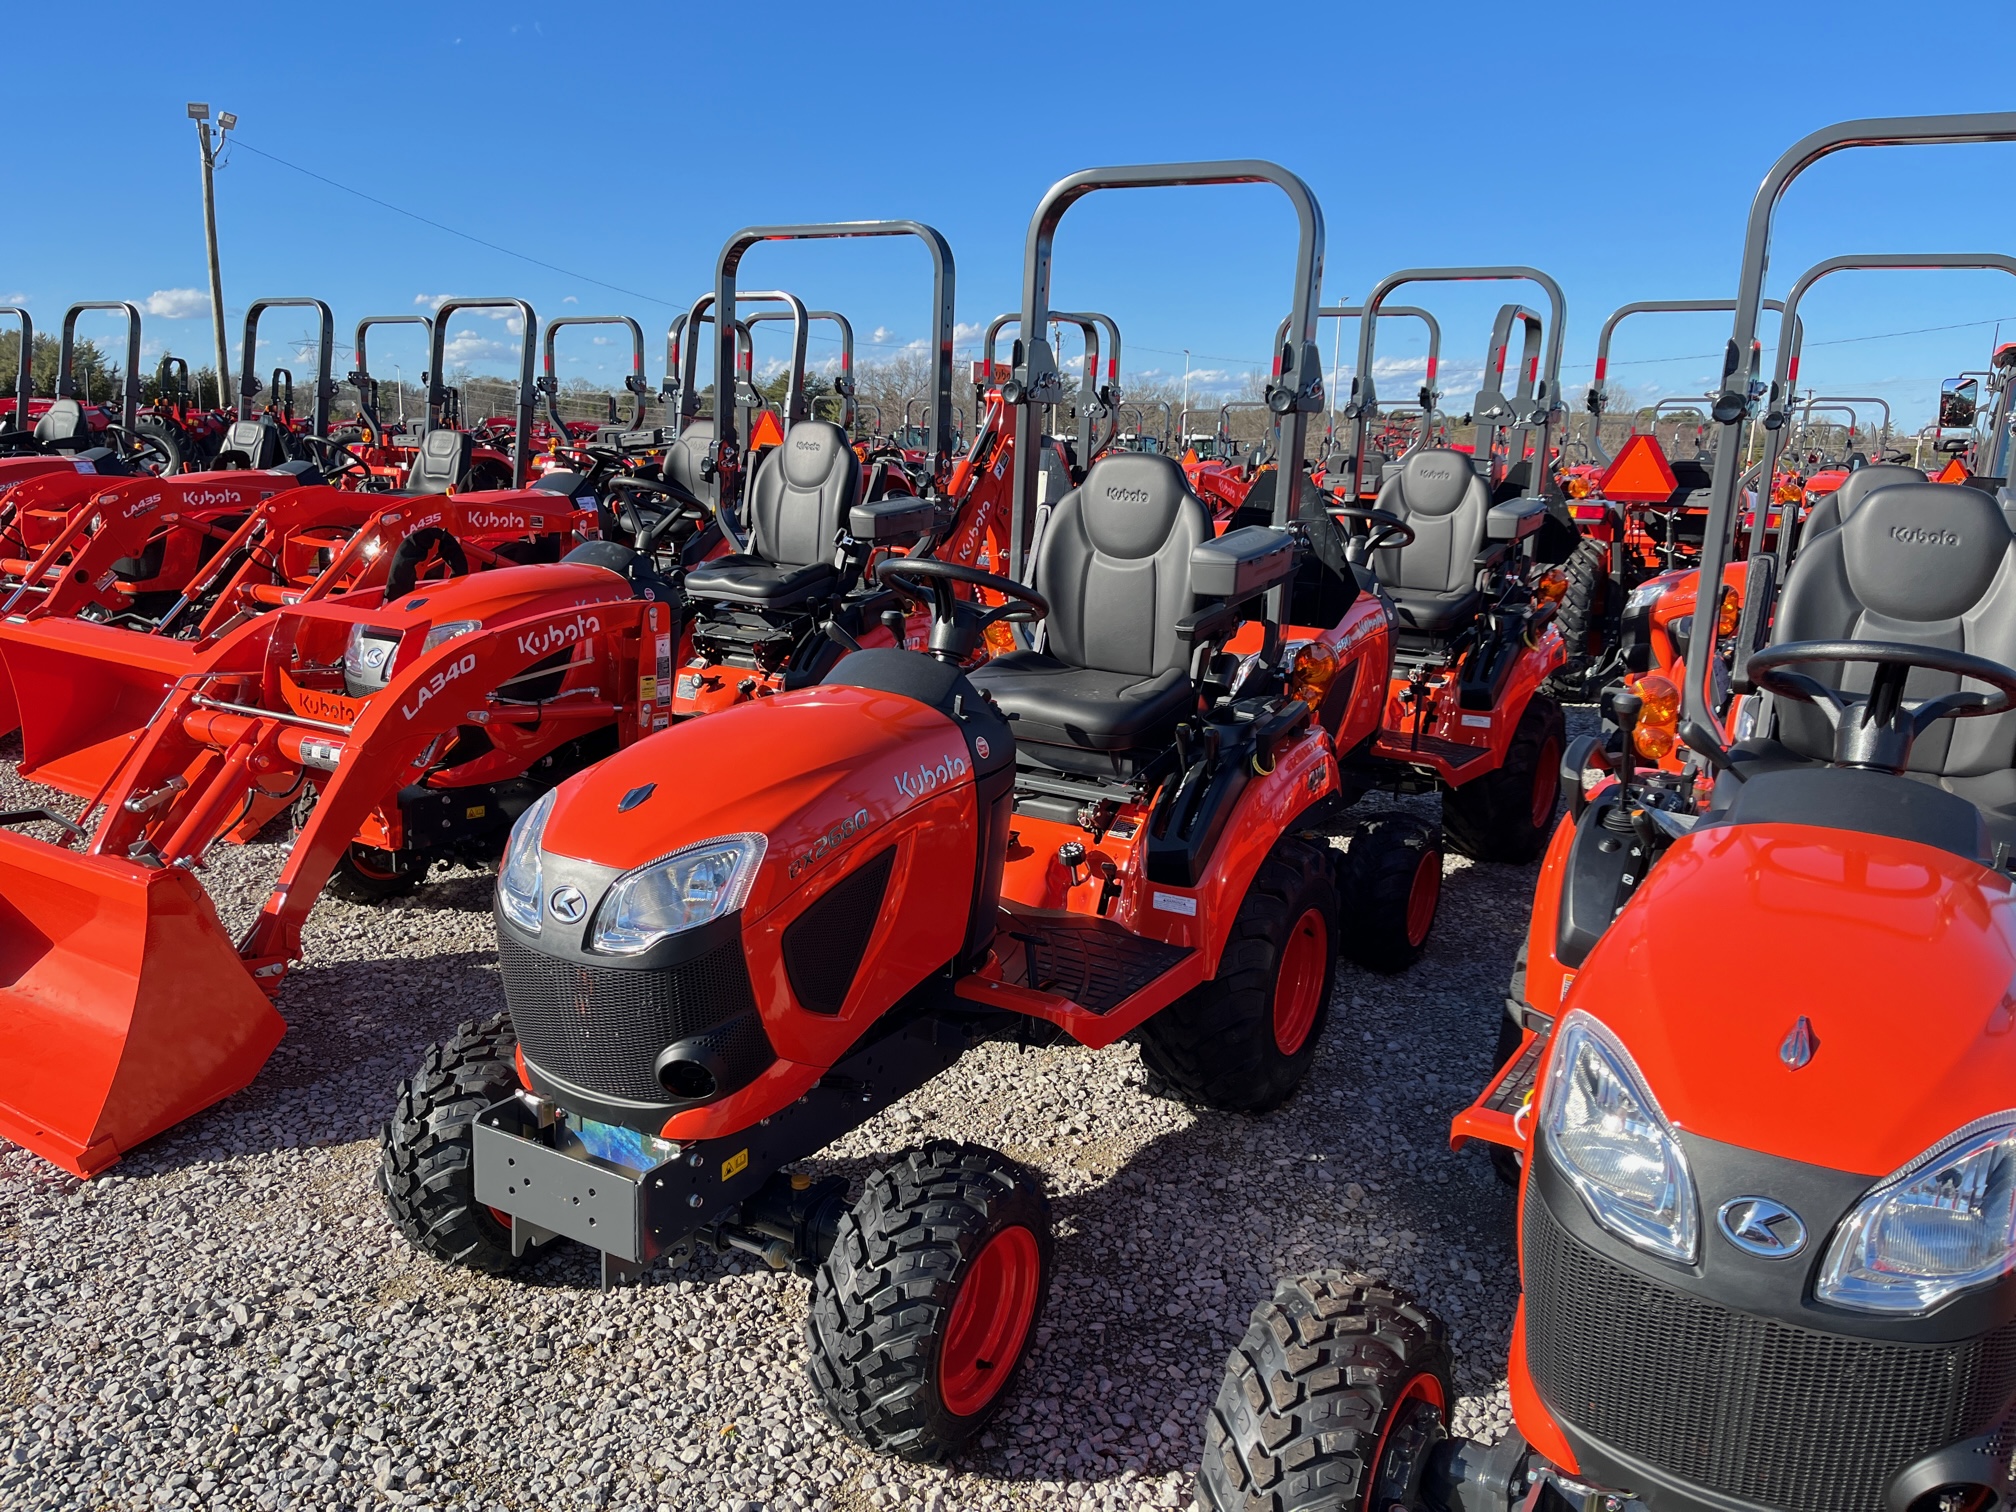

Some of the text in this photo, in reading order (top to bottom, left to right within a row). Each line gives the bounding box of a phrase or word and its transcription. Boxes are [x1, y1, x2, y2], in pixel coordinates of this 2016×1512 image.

[1420, 469, 1451, 480] Kubota
[123, 493, 161, 518] LA435
[183, 489, 241, 505] Kubota
[1107, 487, 1149, 503] Kubota
[468, 511, 524, 528] Kubota
[959, 501, 991, 560] Kubota
[1890, 526, 1960, 547] Kubota
[517, 614, 600, 656] Kubota
[402, 653, 476, 721] LA340
[299, 692, 355, 721] Kubota
[894, 754, 966, 798] Kubota
[788, 808, 869, 880] BX2680
